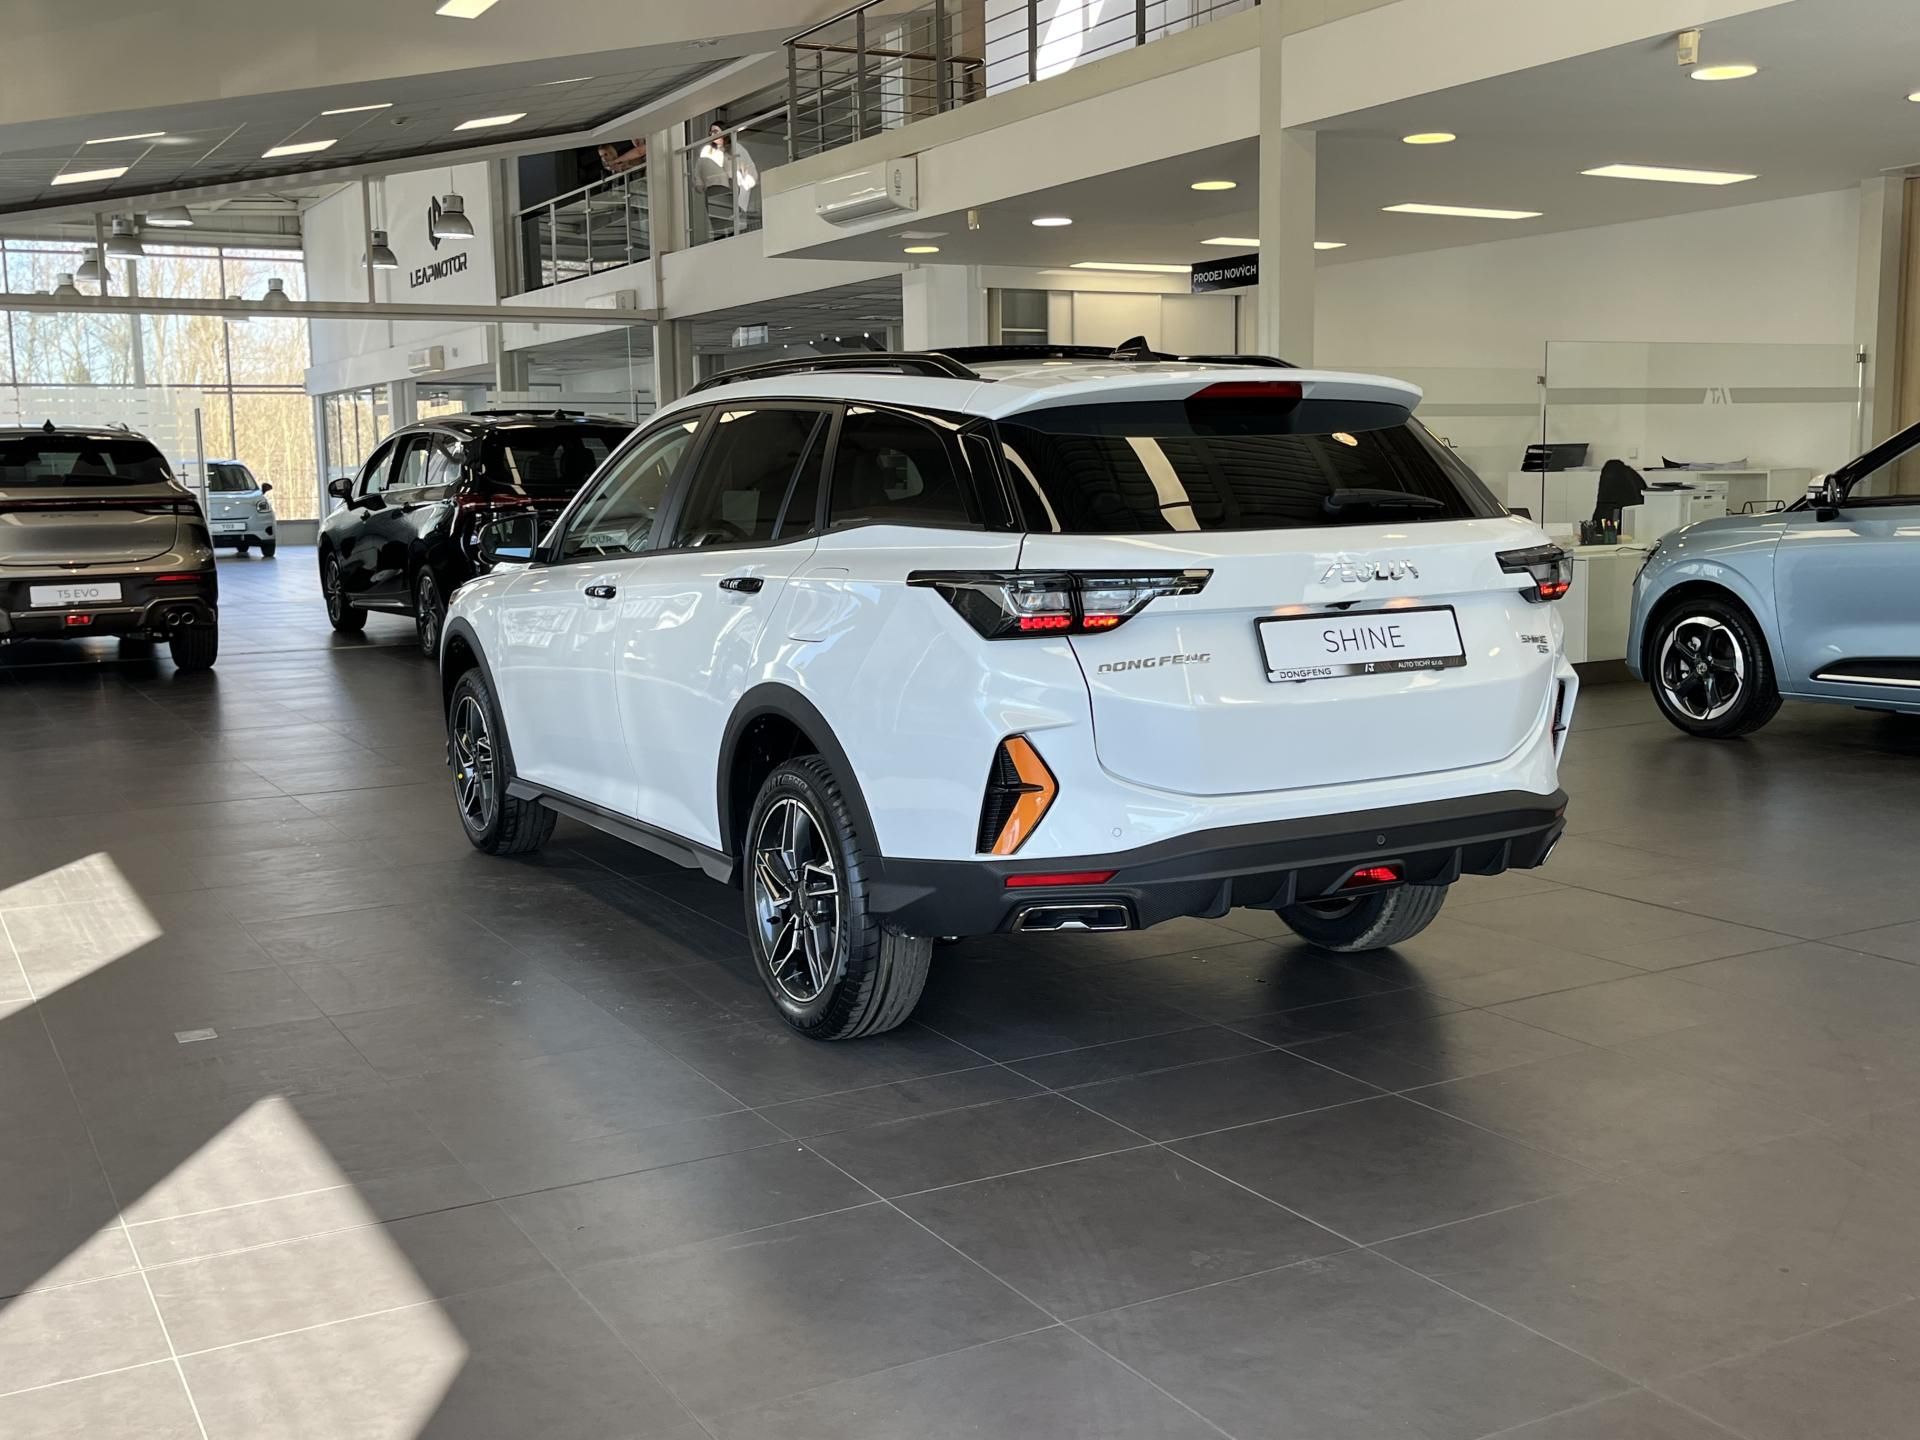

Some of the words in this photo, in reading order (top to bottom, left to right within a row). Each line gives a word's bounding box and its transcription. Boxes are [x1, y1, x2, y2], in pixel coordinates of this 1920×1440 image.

[409, 252, 468, 289] LEAPMOTOR
[1193, 269, 1223, 283] PRODEJ
[1224, 264, 1257, 280] NOVÝCH
[57, 589, 71, 599] T5
[73, 588, 99, 598] EVO
[1322, 624, 1406, 653] SHINE
[1279, 667, 1332, 679] DONGFENG
[1398, 661, 1414, 669] AUTO
